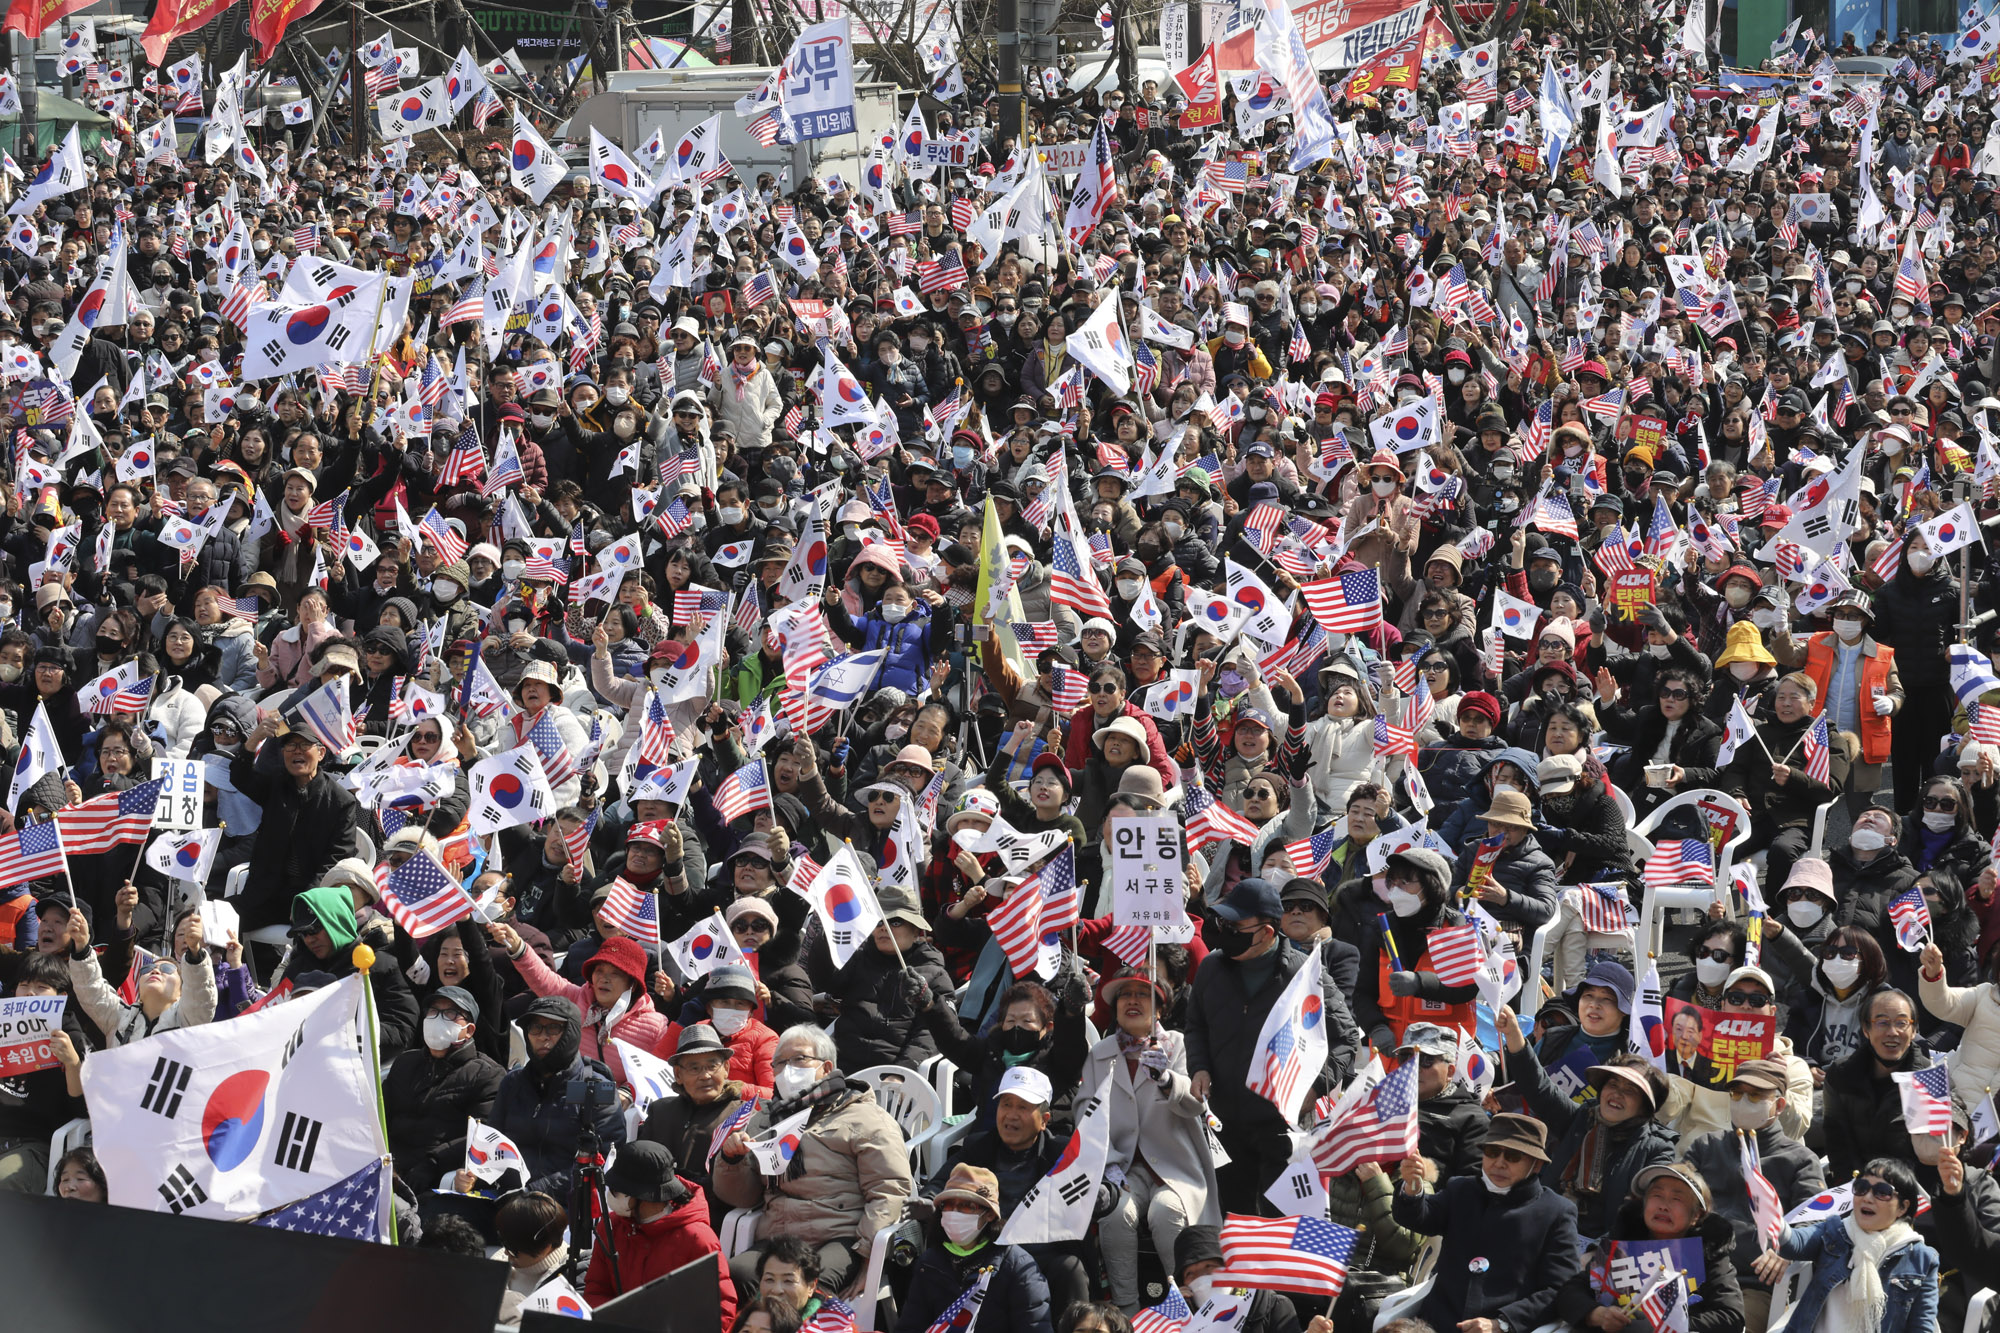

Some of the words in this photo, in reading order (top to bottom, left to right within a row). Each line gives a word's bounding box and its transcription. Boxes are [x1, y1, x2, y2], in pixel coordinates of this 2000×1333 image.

[1638, 419, 1662, 430] 4대4
[1636, 429, 1661, 445] 탄핵
[1617, 574, 1650, 586] 4대4
[1616, 588, 1650, 605] 탄핵
[1618, 605, 1649, 621] 기
[160, 762, 197, 792] 정읍
[157, 795, 197, 825] 고창
[1116, 827, 1177, 859] 안동
[1125, 879, 1175, 895] 서구동
[1132, 911, 1171, 920] 자유마을
[0, 1022, 12, 1038] P
[17, 1018, 48, 1035] OUT
[1714, 1020, 1765, 1037] 4대4
[1712, 1038, 1762, 1063] 탄핵
[1550, 1064, 1586, 1098] 회
[1710, 1062, 1738, 1084] 기
